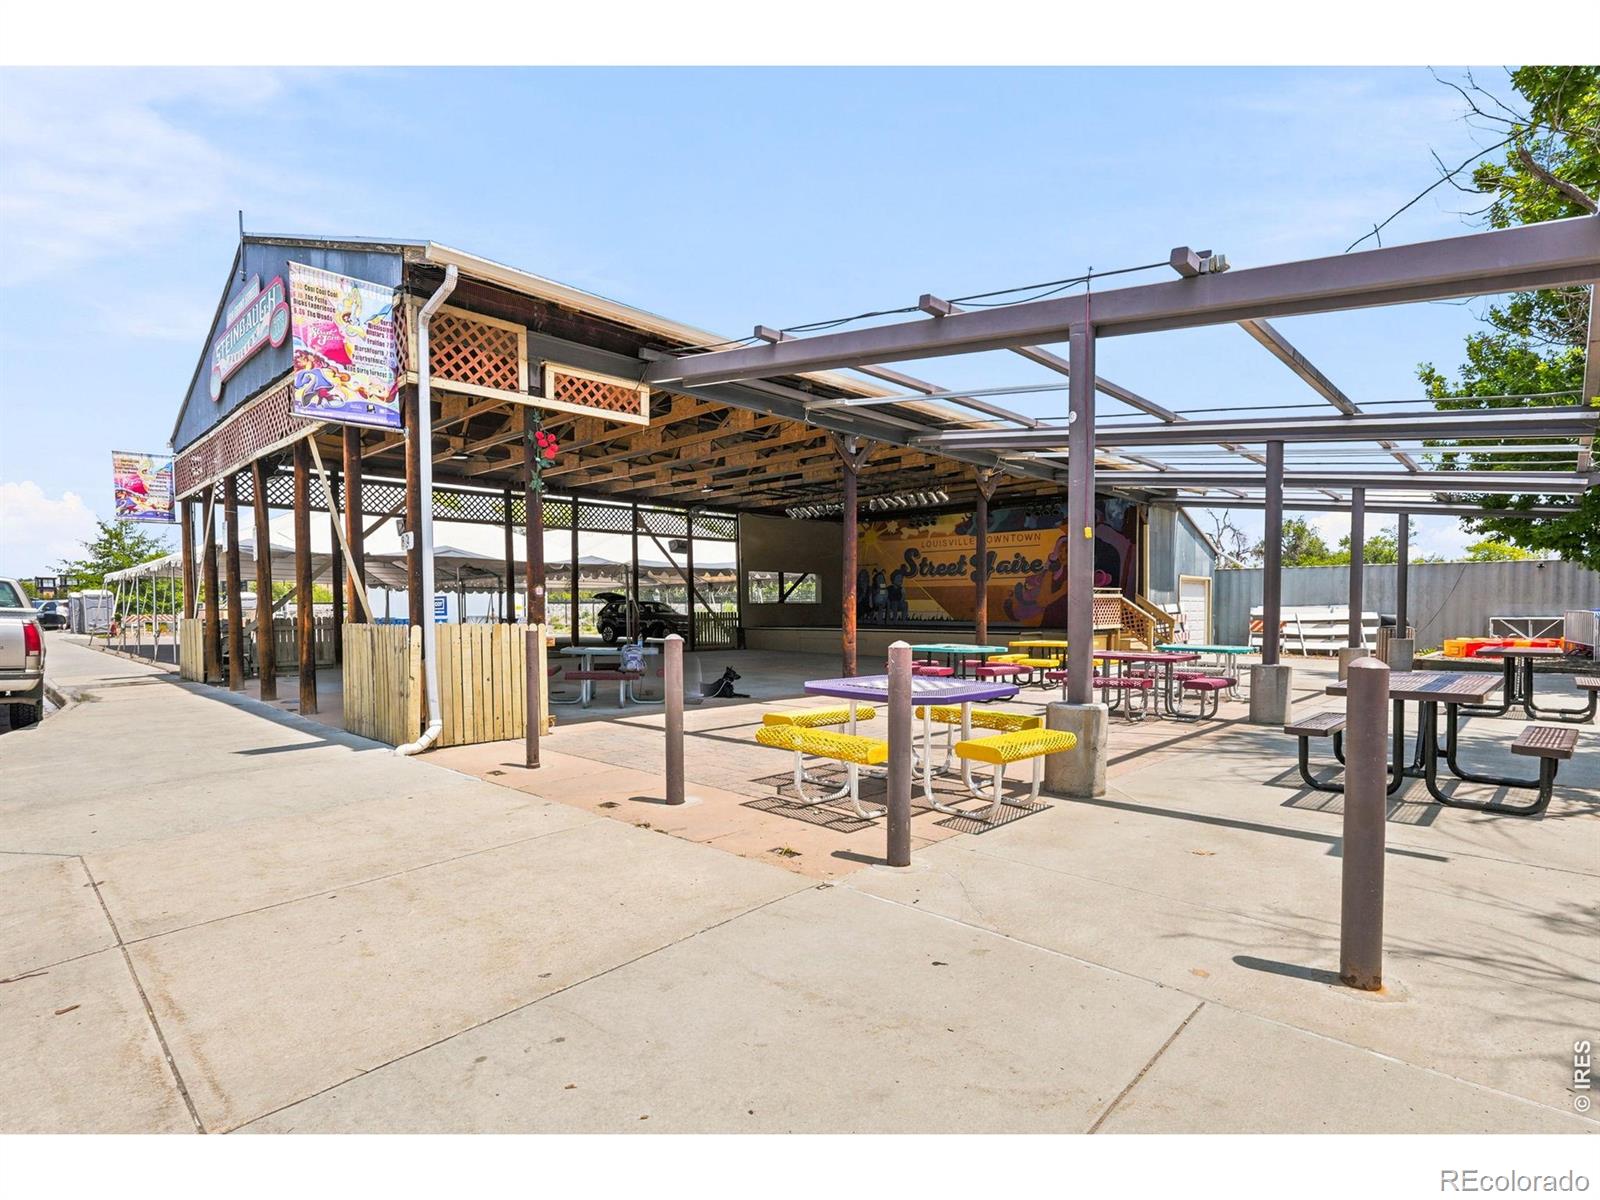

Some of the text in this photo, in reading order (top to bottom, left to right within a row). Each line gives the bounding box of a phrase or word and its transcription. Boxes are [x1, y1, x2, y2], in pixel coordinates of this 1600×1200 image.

[304, 284, 315, 292] Cool
[315, 287, 327, 295] Cool
[327, 290, 339, 298] Cool
[307, 310, 316, 318] The
[216, 286, 276, 366] STEINBAUGH
[921, 532, 1041, 549] LOUISVILLE OWNTOWN
[902, 548, 968, 578] Street
